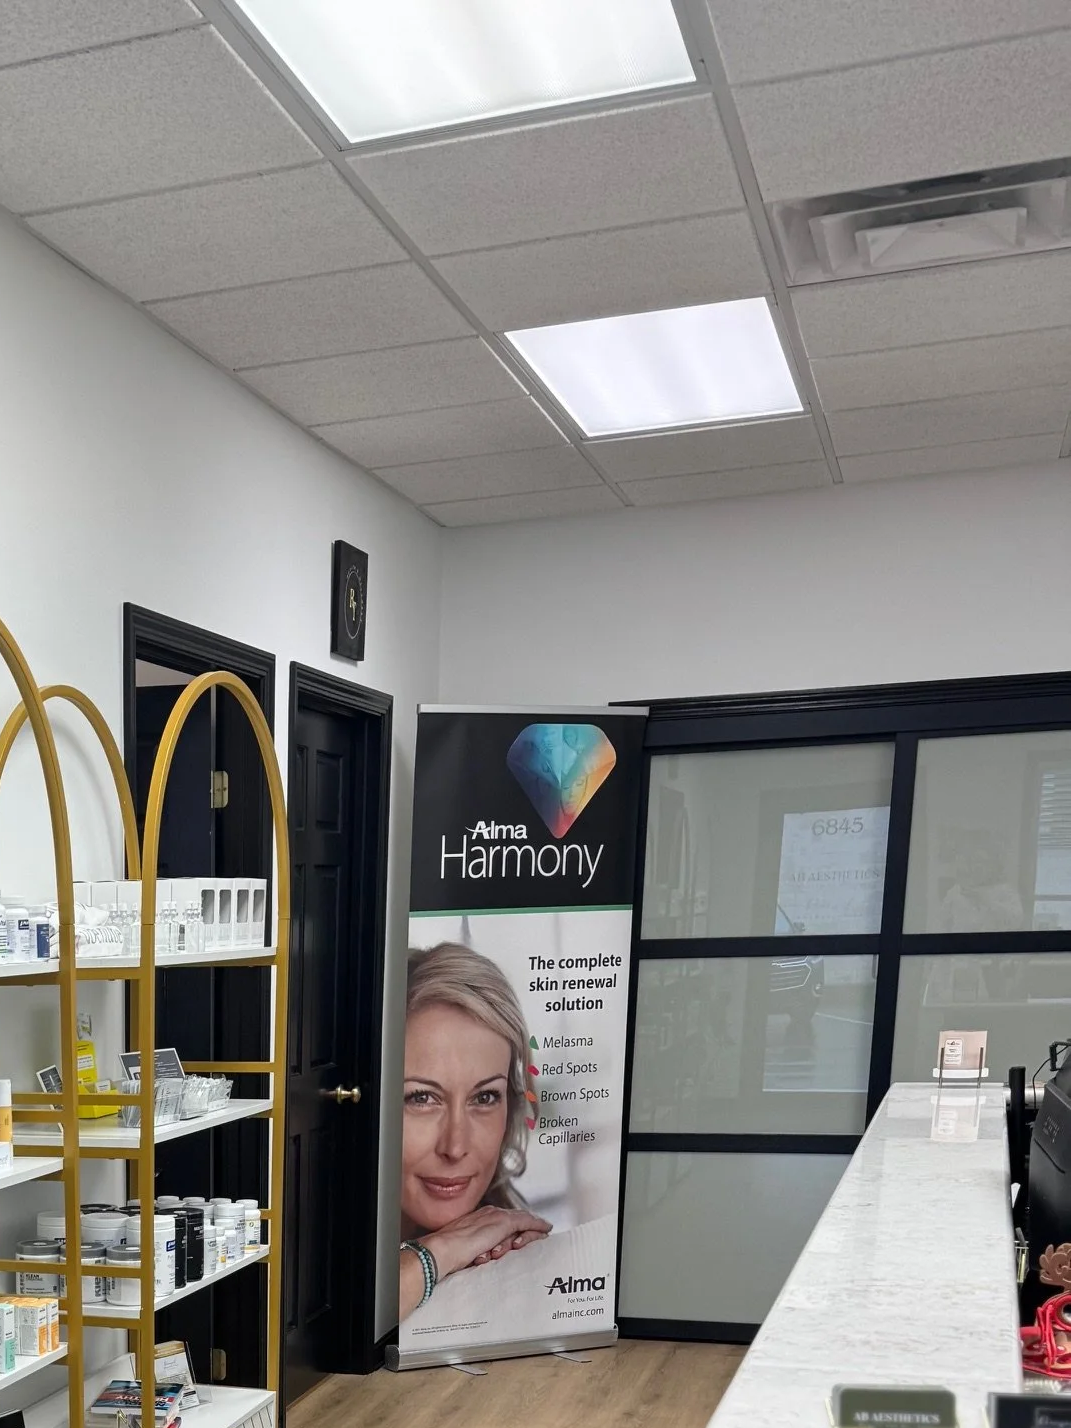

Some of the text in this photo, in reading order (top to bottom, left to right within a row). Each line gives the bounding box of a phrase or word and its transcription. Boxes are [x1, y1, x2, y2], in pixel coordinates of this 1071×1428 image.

[466, 820, 528, 840] Alma
[811, 816, 864, 836] 6845
[440, 834, 604, 888] Harmony
[529, 953, 622, 972] The complete
[529, 973, 617, 992] skin renewal
[545, 996, 603, 1012] solution
[543, 1036, 593, 1049] Melasma
[542, 1062, 598, 1076] Red Spots
[540, 1088, 610, 1102] Brown Spots
[539, 1116, 579, 1129] Broken
[538, 1131, 596, 1147] Capillaries
[544, 1276, 606, 1295] Alma
[552, 1307, 604, 1320] almainc.com
[853, 1411, 941, 1425] AB AESTHETICS
